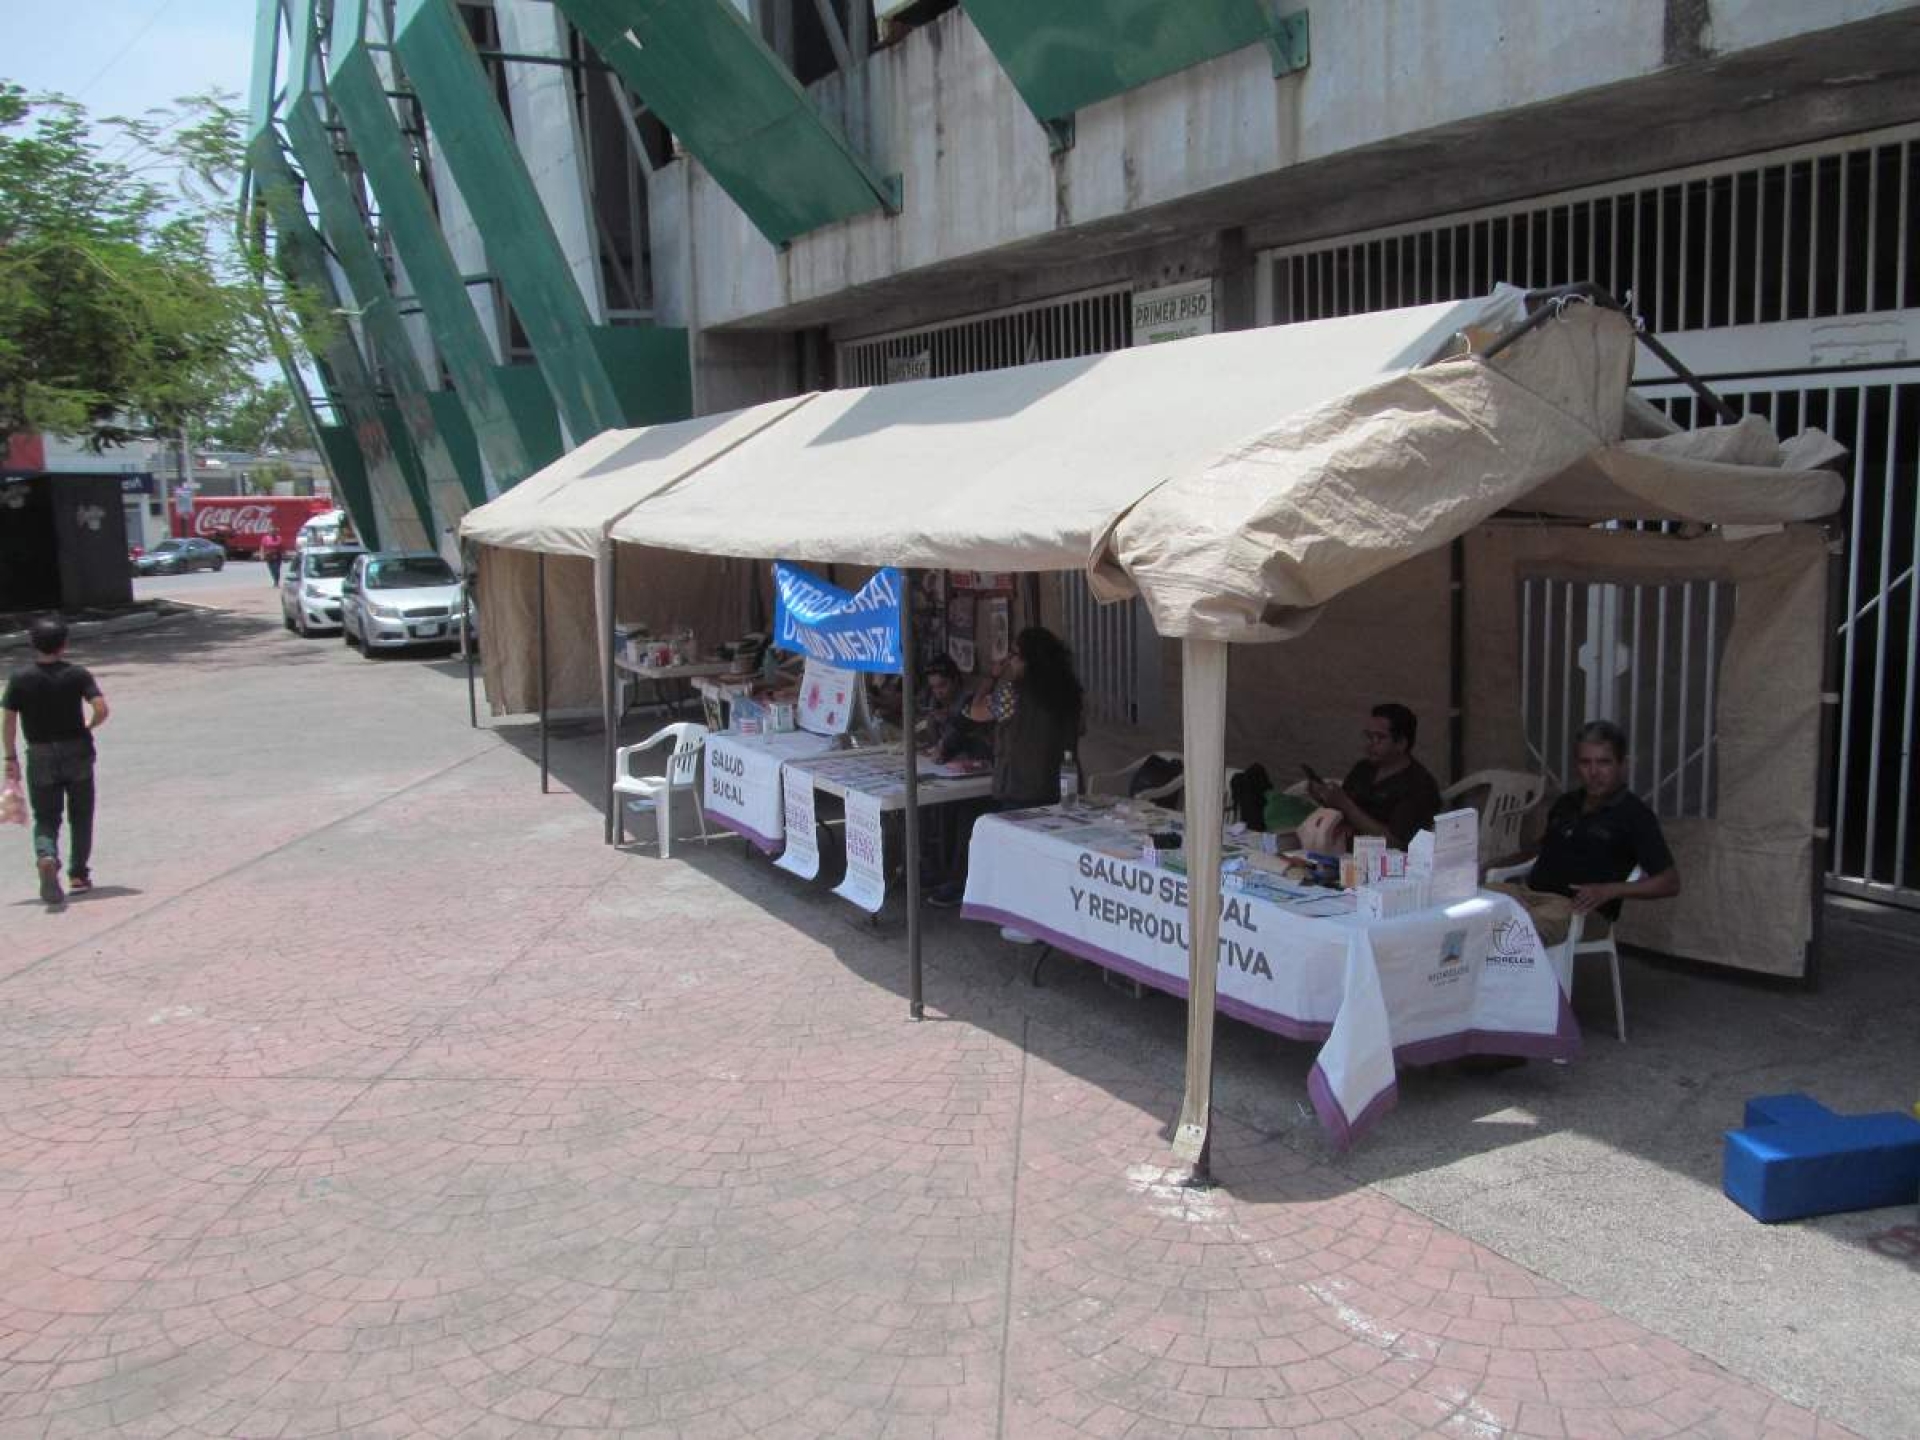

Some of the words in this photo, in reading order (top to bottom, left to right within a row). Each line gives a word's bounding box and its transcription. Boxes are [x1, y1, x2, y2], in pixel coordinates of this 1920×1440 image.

[1135, 299, 1177, 328] PRIMER
[1179, 293, 1207, 320] PISO
[711, 749, 744, 777] SALUD
[1078, 852, 1154, 896] SALUD
[1158, 876, 1258, 932] SEAL
[1070, 886, 1085, 911] Y
[1088, 894, 1273, 980] REPRODUTIVA
